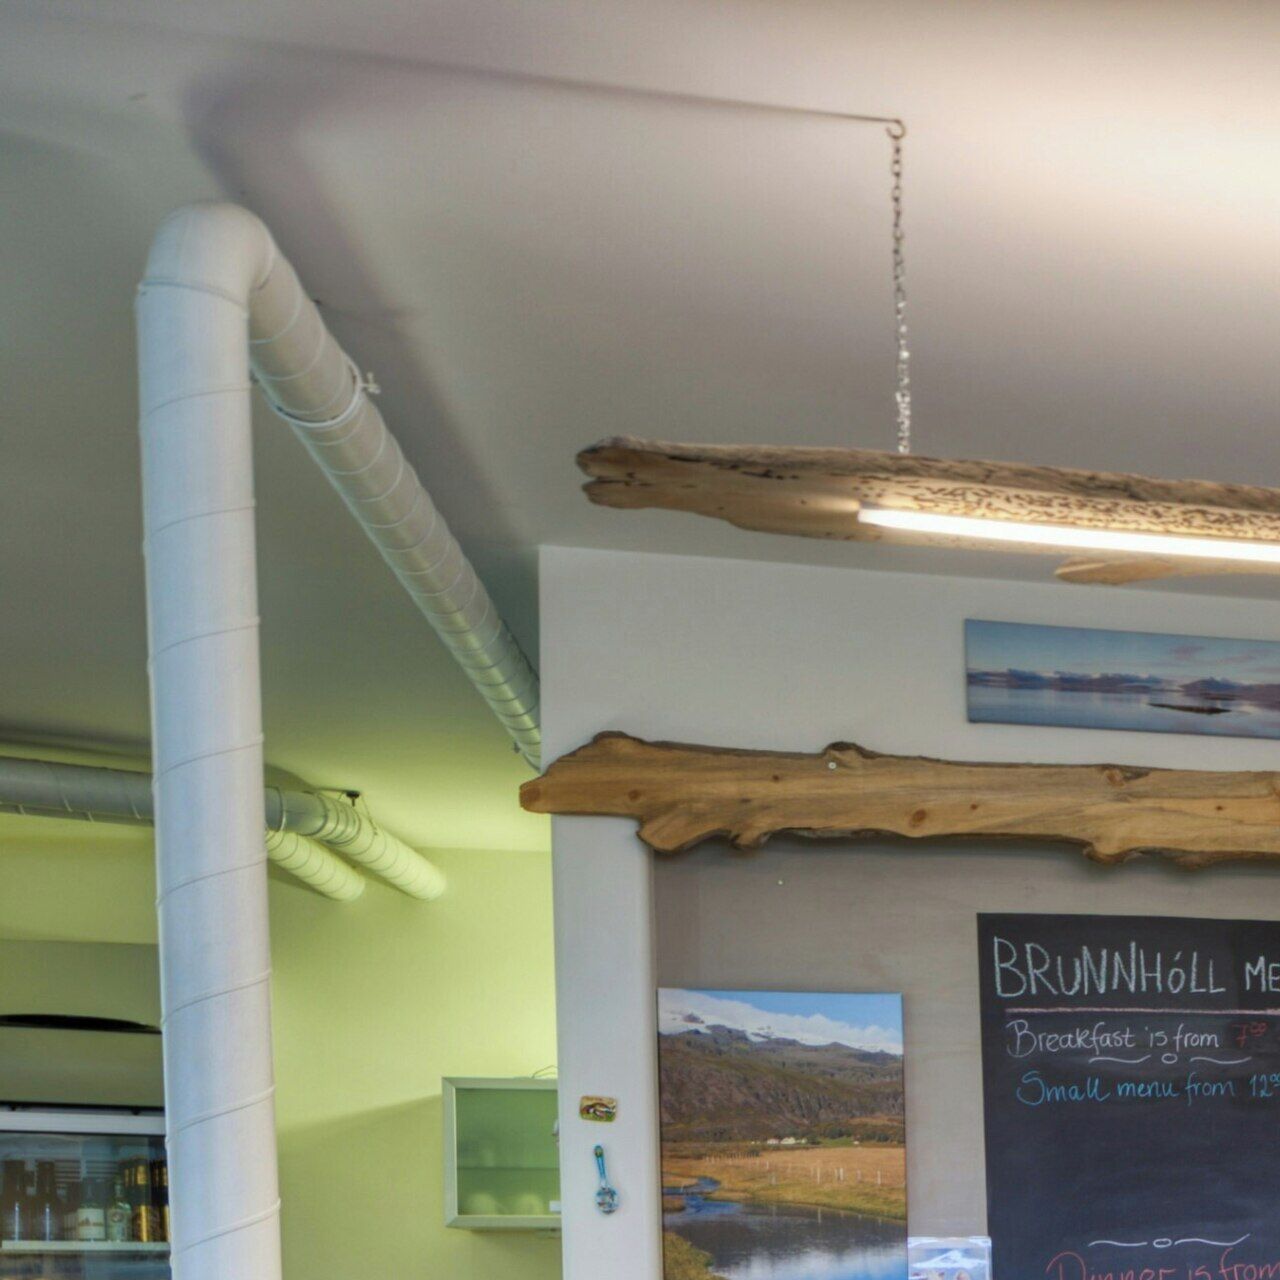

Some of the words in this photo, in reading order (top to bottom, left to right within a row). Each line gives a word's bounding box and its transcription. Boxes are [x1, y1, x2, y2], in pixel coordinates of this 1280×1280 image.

[1005, 1019, 1137, 1058] Breakfast
[1144, 1026, 1168, 1049] is
[1172, 1023, 1219, 1053] from
[1016, 1070, 1111, 1106] Small
[1116, 1079, 1179, 1098] menu
[1185, 1072, 1236, 1107] from
